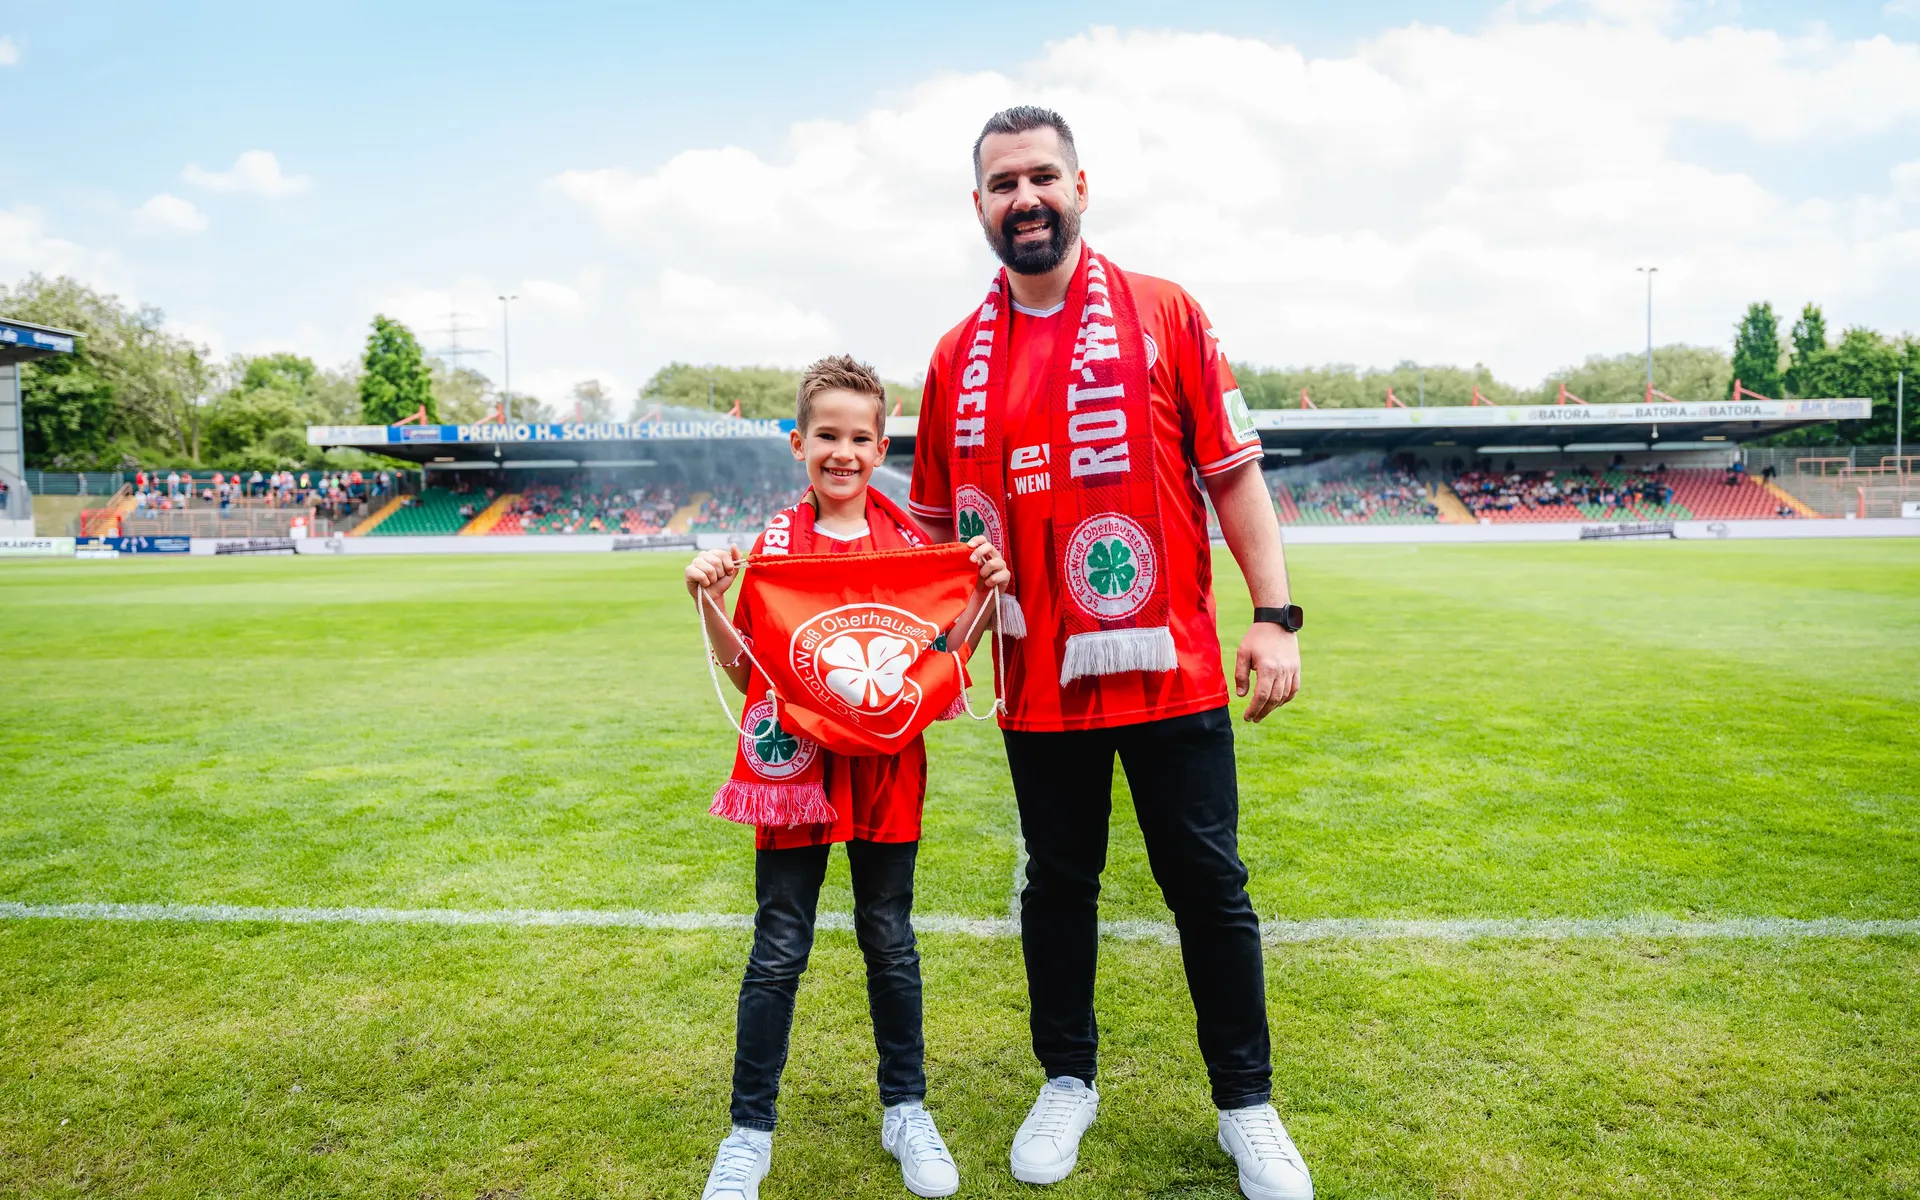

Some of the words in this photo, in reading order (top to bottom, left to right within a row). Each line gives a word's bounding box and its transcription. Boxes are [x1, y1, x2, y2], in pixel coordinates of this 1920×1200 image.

[1539, 409, 1591, 421] BATORA
[1635, 407, 1688, 419] BATORA
[1708, 404, 1762, 417] BATORA
[457, 424, 531, 442] PREMIO
[535, 424, 557, 441] H.
[561, 419, 782, 441] SCHULTE-KELLINGHAUS
[794, 628, 831, 704] Rot-Weiß
